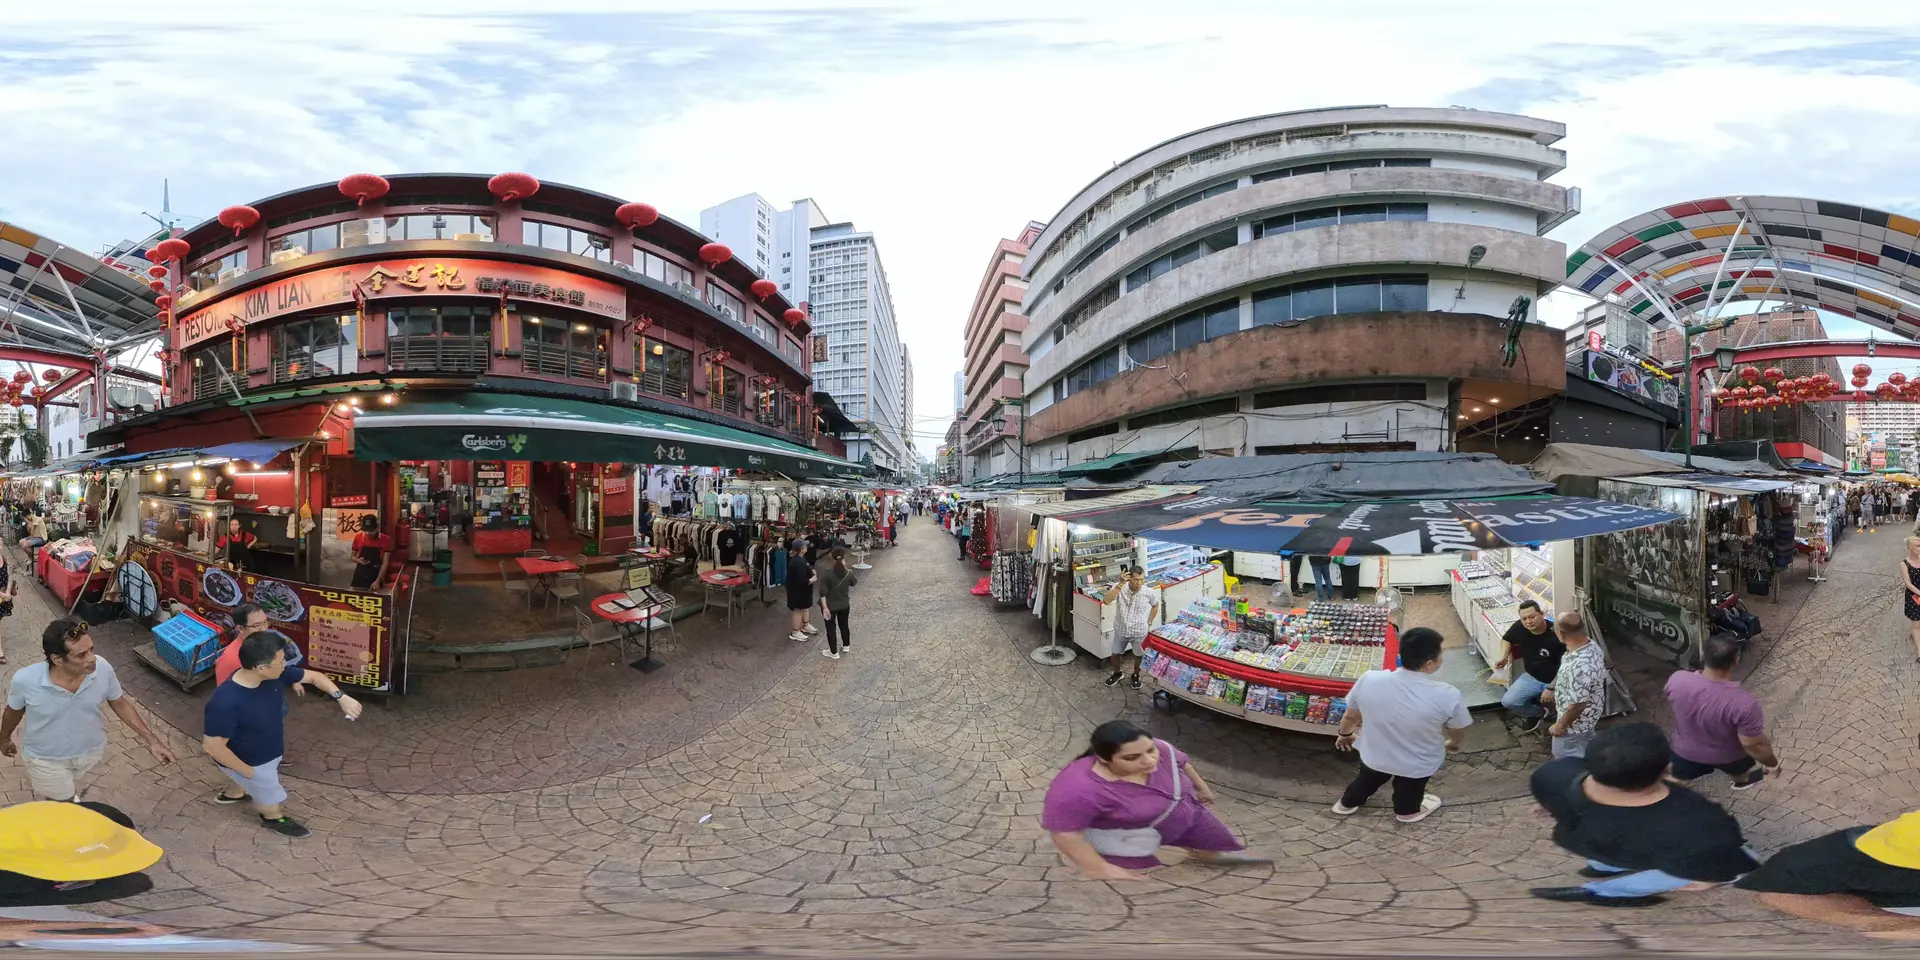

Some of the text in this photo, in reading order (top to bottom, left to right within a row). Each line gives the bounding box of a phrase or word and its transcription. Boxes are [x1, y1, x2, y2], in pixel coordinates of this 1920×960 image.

[244, 290, 270, 321] KIM
[277, 279, 312, 311] LIAN
[461, 434, 506, 451] Carlsberg
[197, 563, 204, 573] A
[247, 576, 255, 585] B
[198, 606, 204, 614] C
